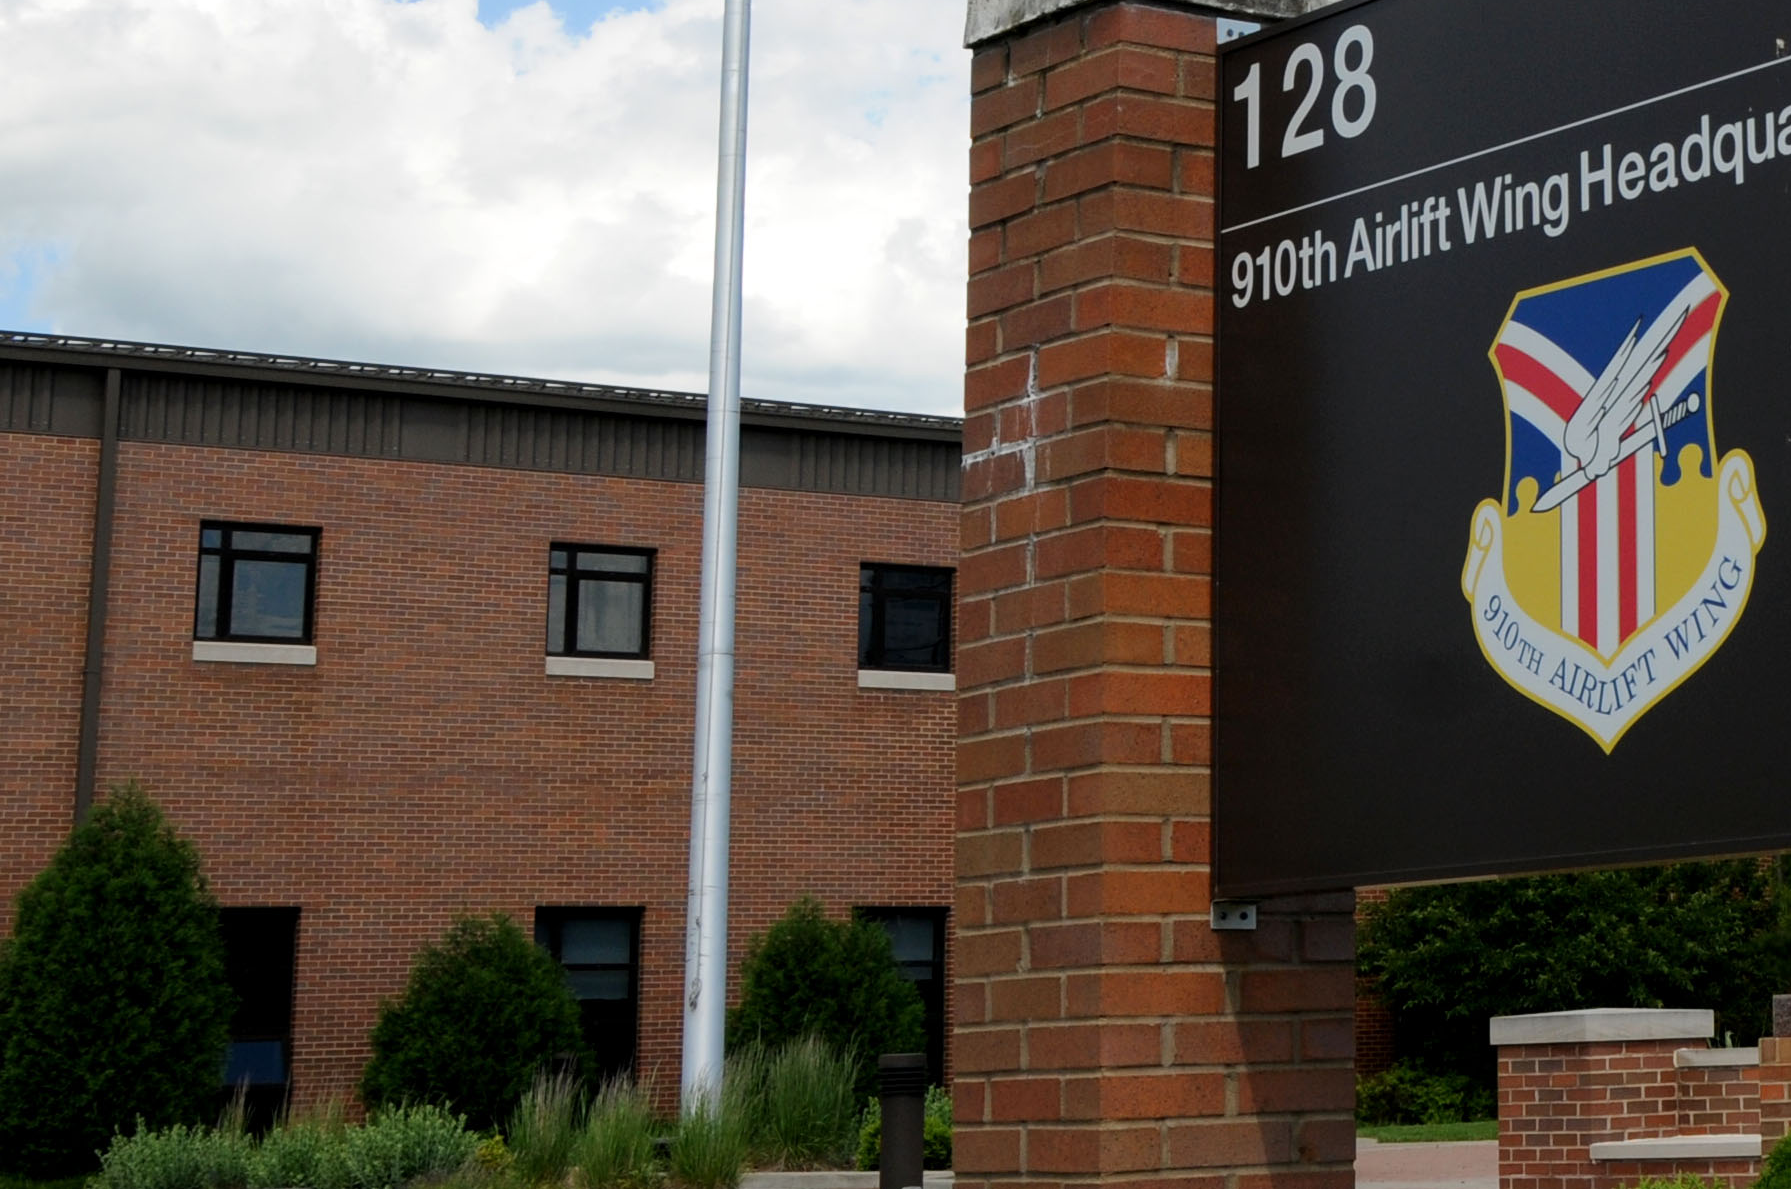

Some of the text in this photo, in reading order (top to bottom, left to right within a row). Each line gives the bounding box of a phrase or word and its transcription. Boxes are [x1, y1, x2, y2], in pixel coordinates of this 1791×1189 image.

[1232, 23, 1378, 170] 128
[1230, 229, 1338, 309] 910th
[1343, 195, 1452, 279] Airlift
[1457, 171, 1571, 238] Wing
[1483, 555, 1743, 715] 910TH AIRLIFT WING
